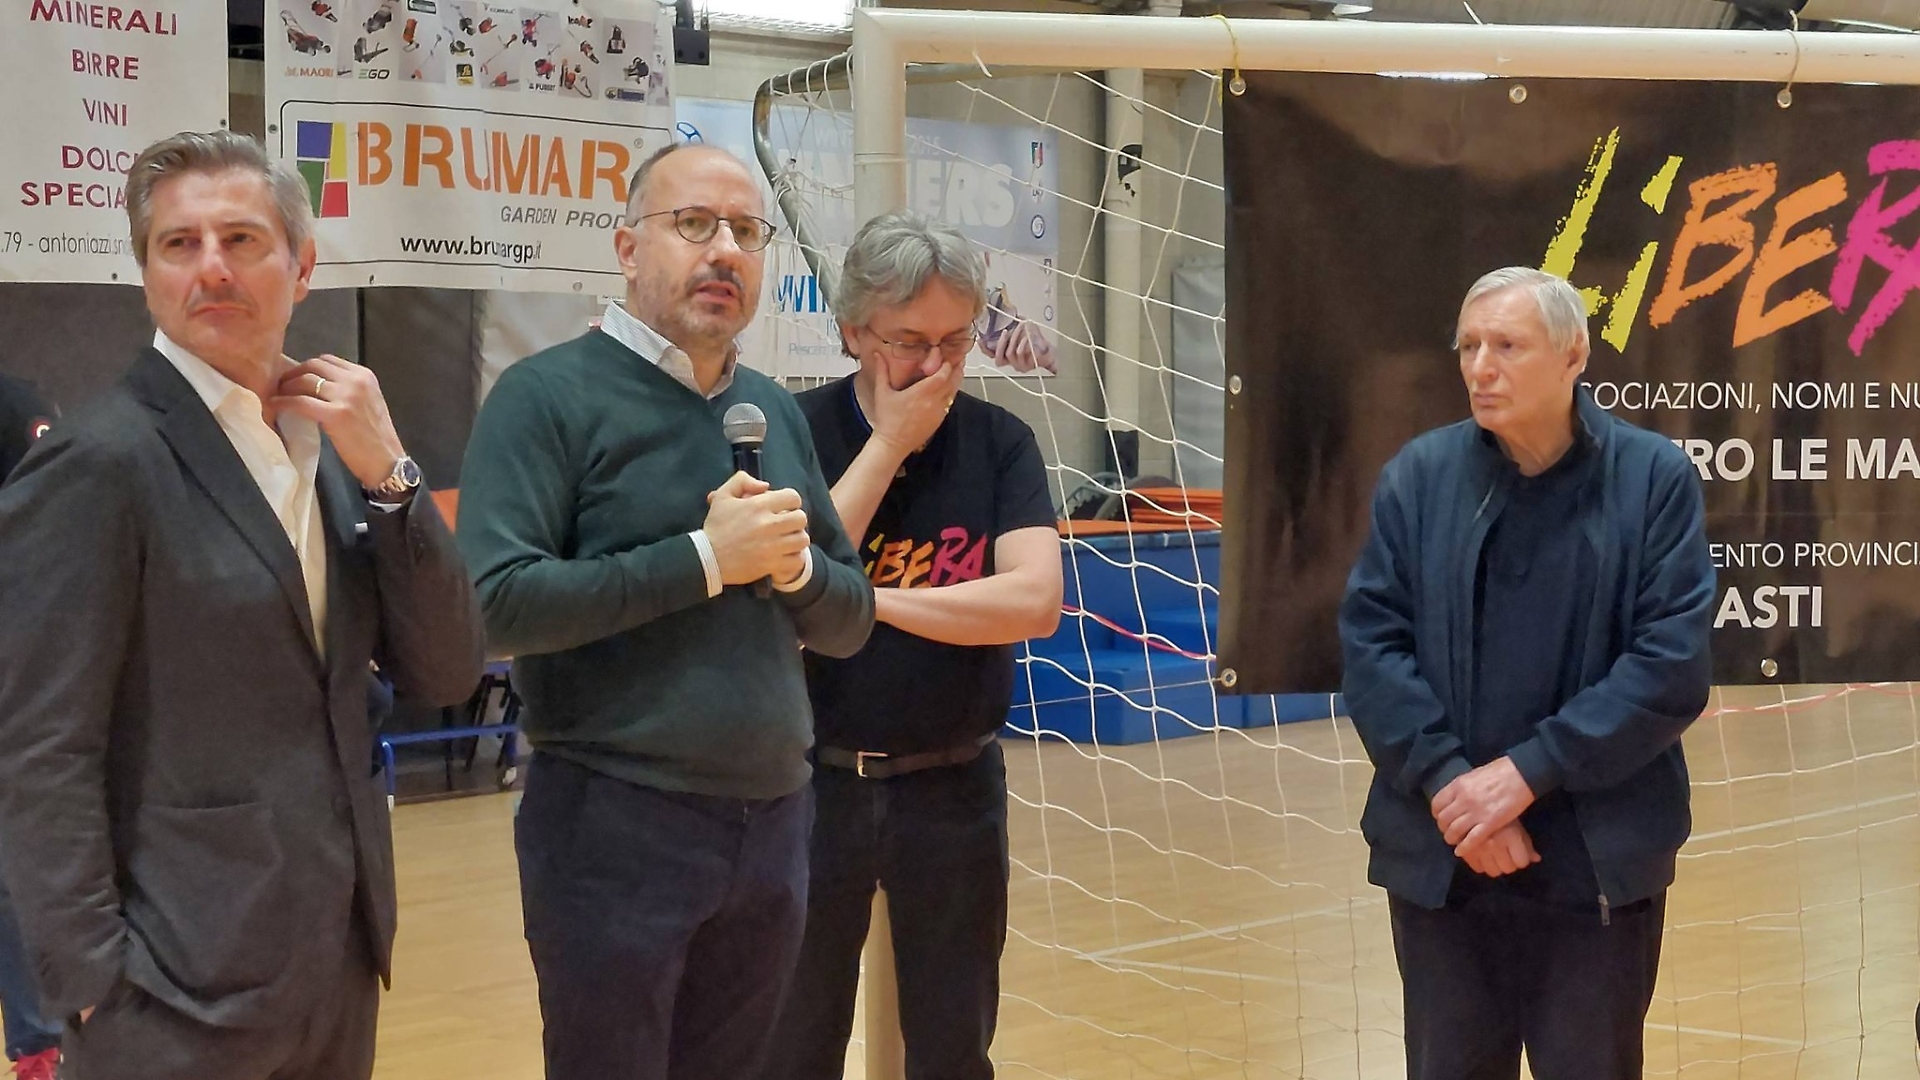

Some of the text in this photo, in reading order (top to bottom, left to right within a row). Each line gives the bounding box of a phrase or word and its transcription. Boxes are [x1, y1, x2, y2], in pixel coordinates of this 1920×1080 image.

[30, 0, 177, 35] MINERALI
[72, 49, 139, 80] BIRRE
[358, 69, 390, 79] EGO
[83, 98, 127, 126] VINI
[358, 122, 631, 202] BRUMAR
[501, 206, 557, 224] GARDEN
[1581, 381, 1760, 413] OCIAZIONI,
[1772, 382, 1854, 409] NOMI
[1865, 382, 1880, 408] E
[1671, 438, 1920, 481] RO LE MA
[1795, 541, 1920, 567] PROVINCI
[1713, 586, 1822, 629] ASTI
